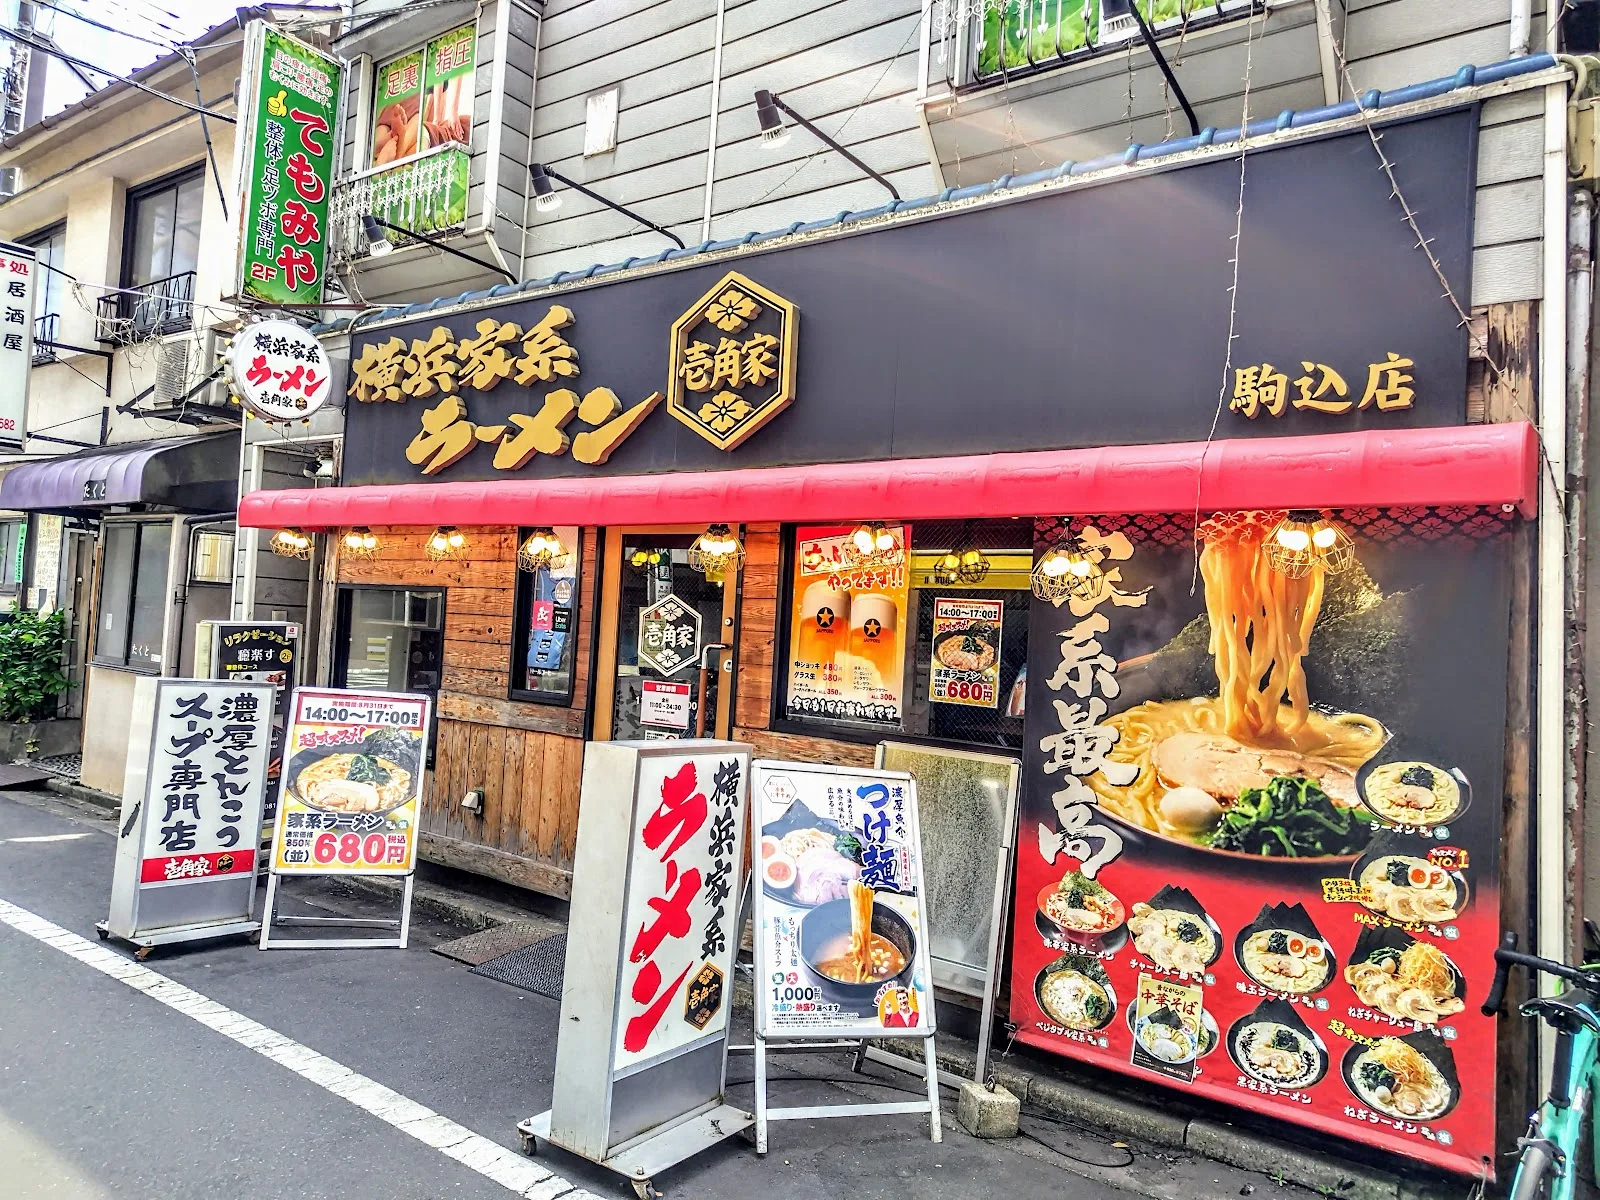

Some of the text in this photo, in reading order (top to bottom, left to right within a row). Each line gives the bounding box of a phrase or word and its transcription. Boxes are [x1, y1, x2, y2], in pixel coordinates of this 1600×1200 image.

[436, 38, 472, 75] 指圧
[385, 63, 418, 99] 足裏
[255, 120, 284, 259] 整体・足ツボ専門
[277, 108, 329, 291] てもみや
[251, 263, 277, 282] 2F
[4, 281, 26, 351] 居酒屋
[254, 332, 320, 363] 横浜家系
[347, 305, 580, 403] 横浜家系
[679, 333, 782, 392] 壱角家
[246, 355, 327, 396] ラーメン
[1229, 351, 1417, 420] 駒込店
[406, 387, 664, 475] ラーメン
[84, 483, 106, 498] たくと
[132, 644, 149, 656] たくと
[224, 629, 292, 647] リラクゼーション
[645, 622, 695, 648] 壱角家
[305, 707, 410, 724] 14:00〜17:00
[1038, 525, 1153, 880] 家系最高
[159, 692, 213, 851] スープ専門店
[211, 692, 260, 847] 濃厚とんこつ
[287, 813, 383, 830] 家系ラーメン
[892, 786, 906, 838] 濃厚魚介
[1370, 820, 1415, 835] ラーメン
[387, 835, 406, 843] 税込
[856, 784, 900, 891] つけ麺
[284, 850, 309, 862] (並)
[700, 758, 741, 961] 横浜家系
[624, 761, 707, 1053] ラーメン
[1354, 913, 1380, 926] MAX
[1382, 919, 1424, 933] ラーメン
[1141, 989, 1198, 1015] 中華そば
[1156, 984, 1186, 996] 昔ながらの
[1236, 982, 1299, 1003] 味玉ラーメン
[1344, 1105, 1417, 1133] ねぎラーメン
